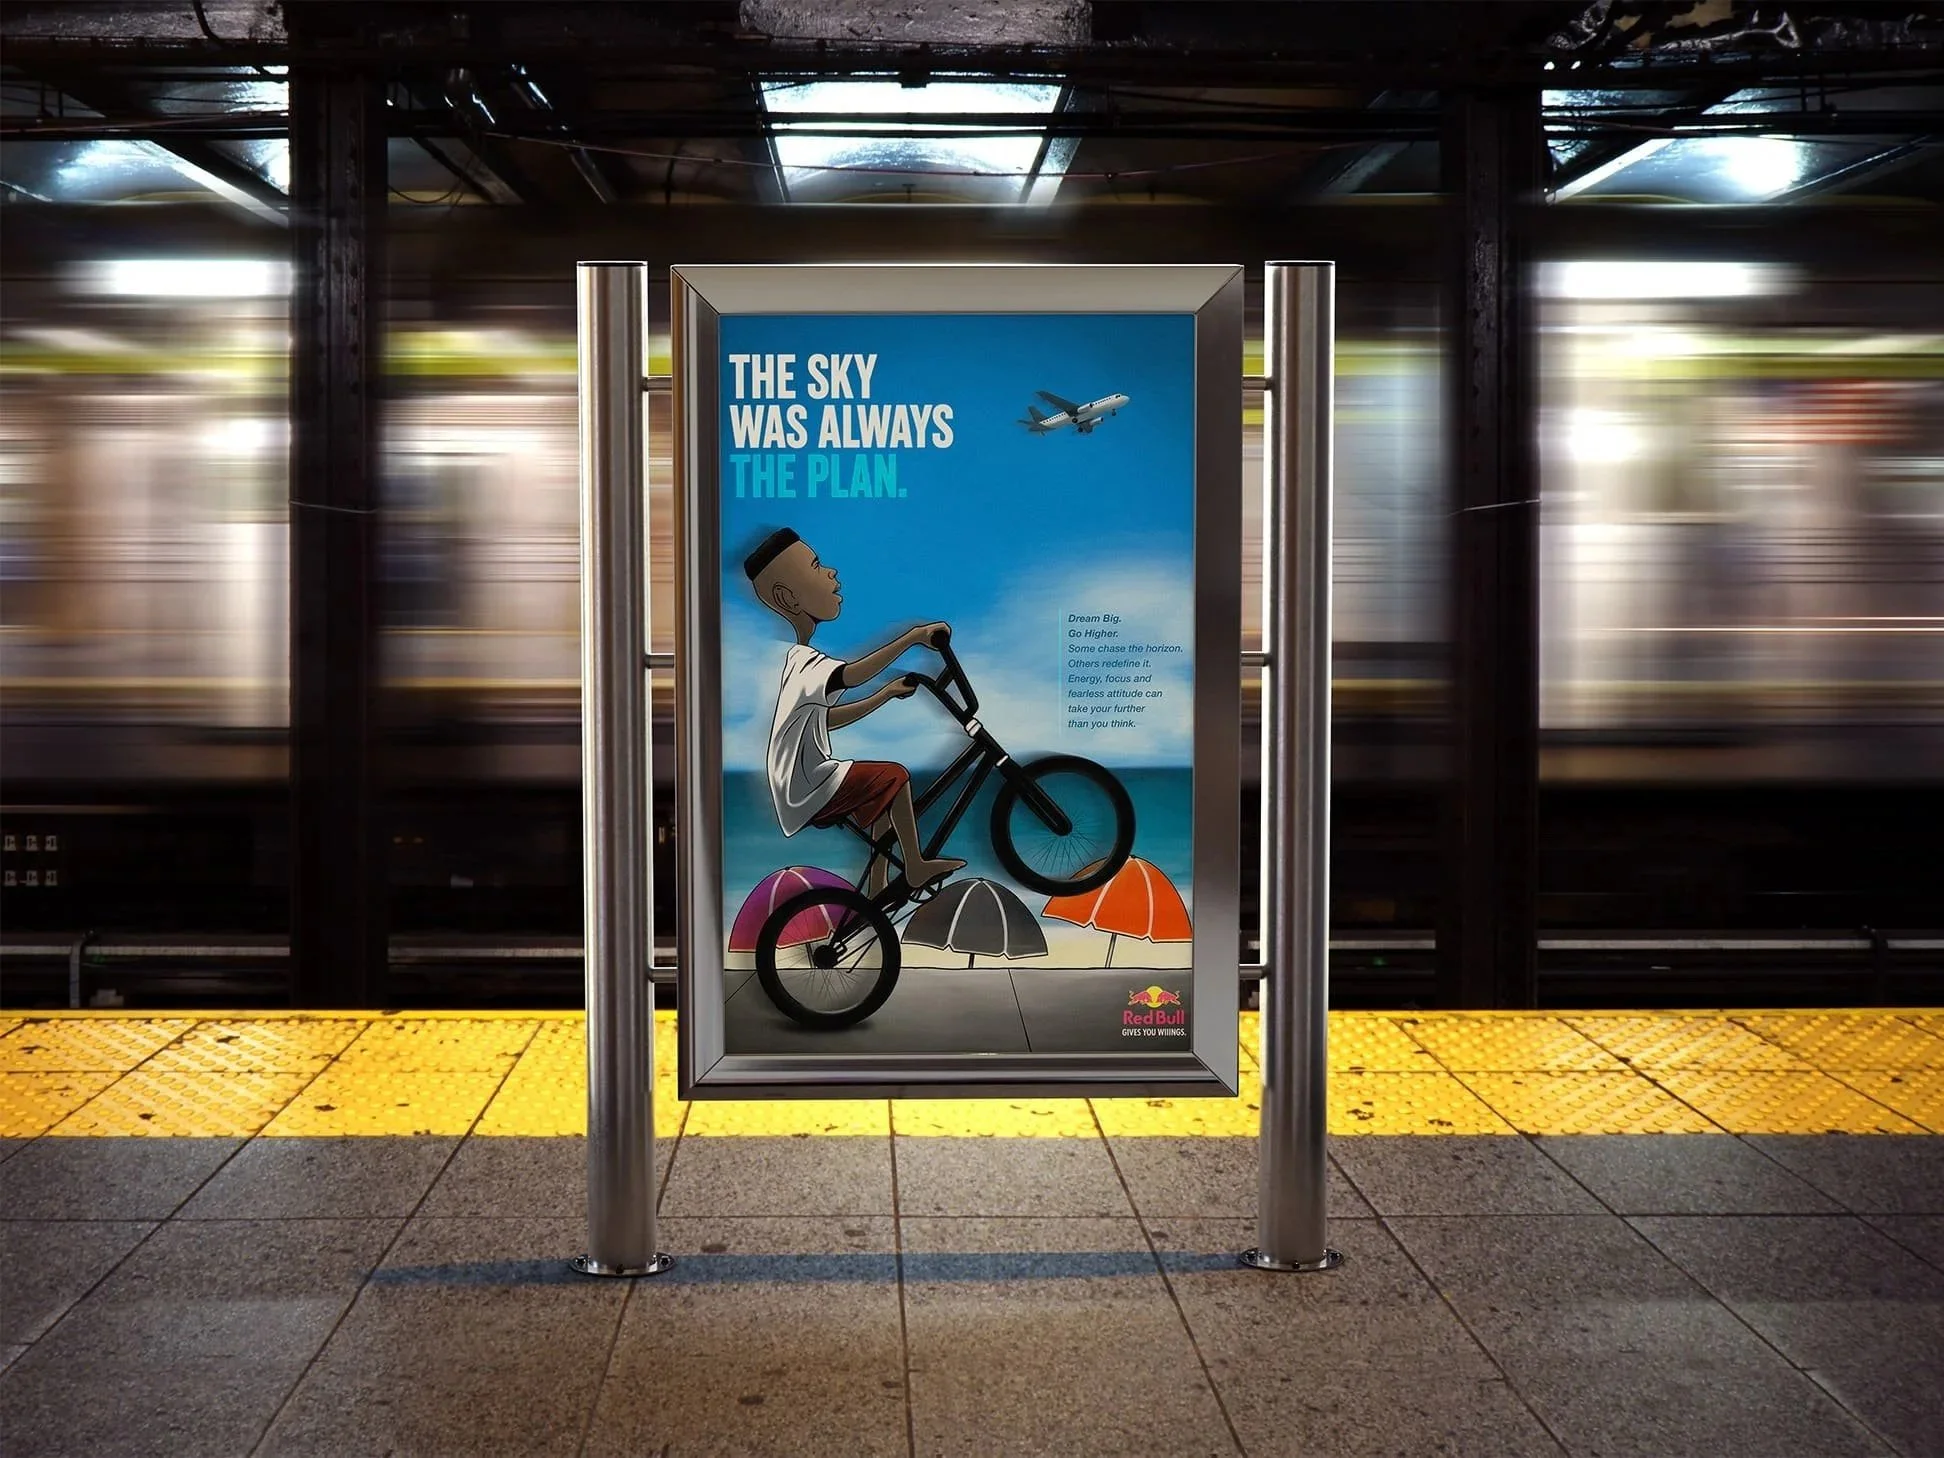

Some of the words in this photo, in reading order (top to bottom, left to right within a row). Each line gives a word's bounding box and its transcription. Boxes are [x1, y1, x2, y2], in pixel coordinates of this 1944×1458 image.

[729, 353, 796, 399] THE
[807, 353, 878, 400] SKY
[729, 404, 808, 449] WAS
[818, 404, 954, 449] ALWAYS
[729, 454, 796, 498] THE
[807, 454, 907, 498] PLAN.
[1068, 614, 1100, 623] Dream
[1102, 614, 1122, 624] Big.
[1068, 629, 1082, 638] Go
[1084, 629, 1119, 640] Higher.
[1068, 644, 1096, 653] Some
[1098, 644, 1126, 653] chase
[1128, 644, 1144, 653] the
[1145, 644, 1183, 653] horizon.
[1068, 659, 1100, 668] Others
[1101, 659, 1140, 668] redefine
[1143, 659, 1151, 668] it.
[1068, 674, 1103, 685] Energy,
[1105, 674, 1131, 683] focus
[1133, 674, 1152, 683] and
[1068, 689, 1105, 698] fearless
[1106, 689, 1143, 698] attitude
[1068, 704, 1088, 713] take
[1090, 706, 1112, 715] your
[1113, 704, 1146, 713] further
[1068, 719, 1089, 728] than
[1091, 721, 1108, 730] you
[1111, 719, 1136, 728] think.
[1123, 1010, 1154, 1025] Red
[1156, 1010, 1185, 1025] Bull
[1121, 1028, 1141, 1036] GIVES
[1142, 1028, 1156, 1036] YOU
